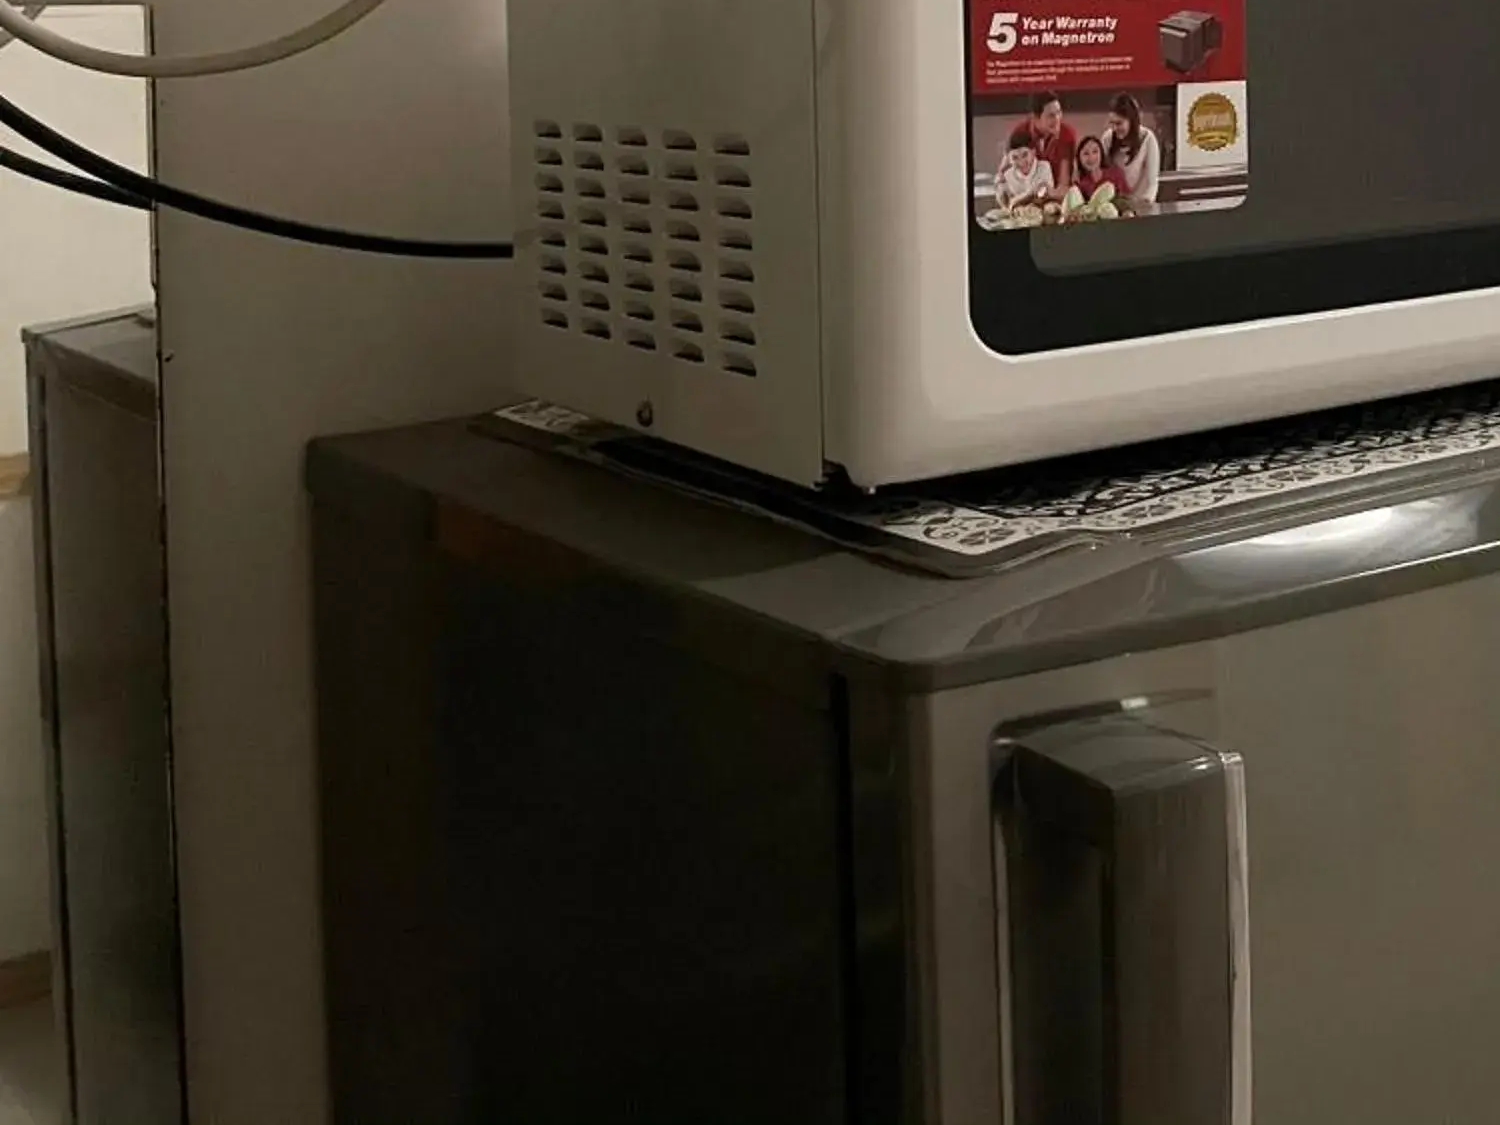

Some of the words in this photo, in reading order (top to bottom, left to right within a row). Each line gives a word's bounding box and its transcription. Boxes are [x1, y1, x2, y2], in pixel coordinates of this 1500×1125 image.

[1022, 17, 1054, 30] Year
[1055, 16, 1118, 30] Warranty
[986, 12, 1019, 54] 5
[1021, 34, 1040, 46] on
[1041, 32, 1116, 47] Magnetron
